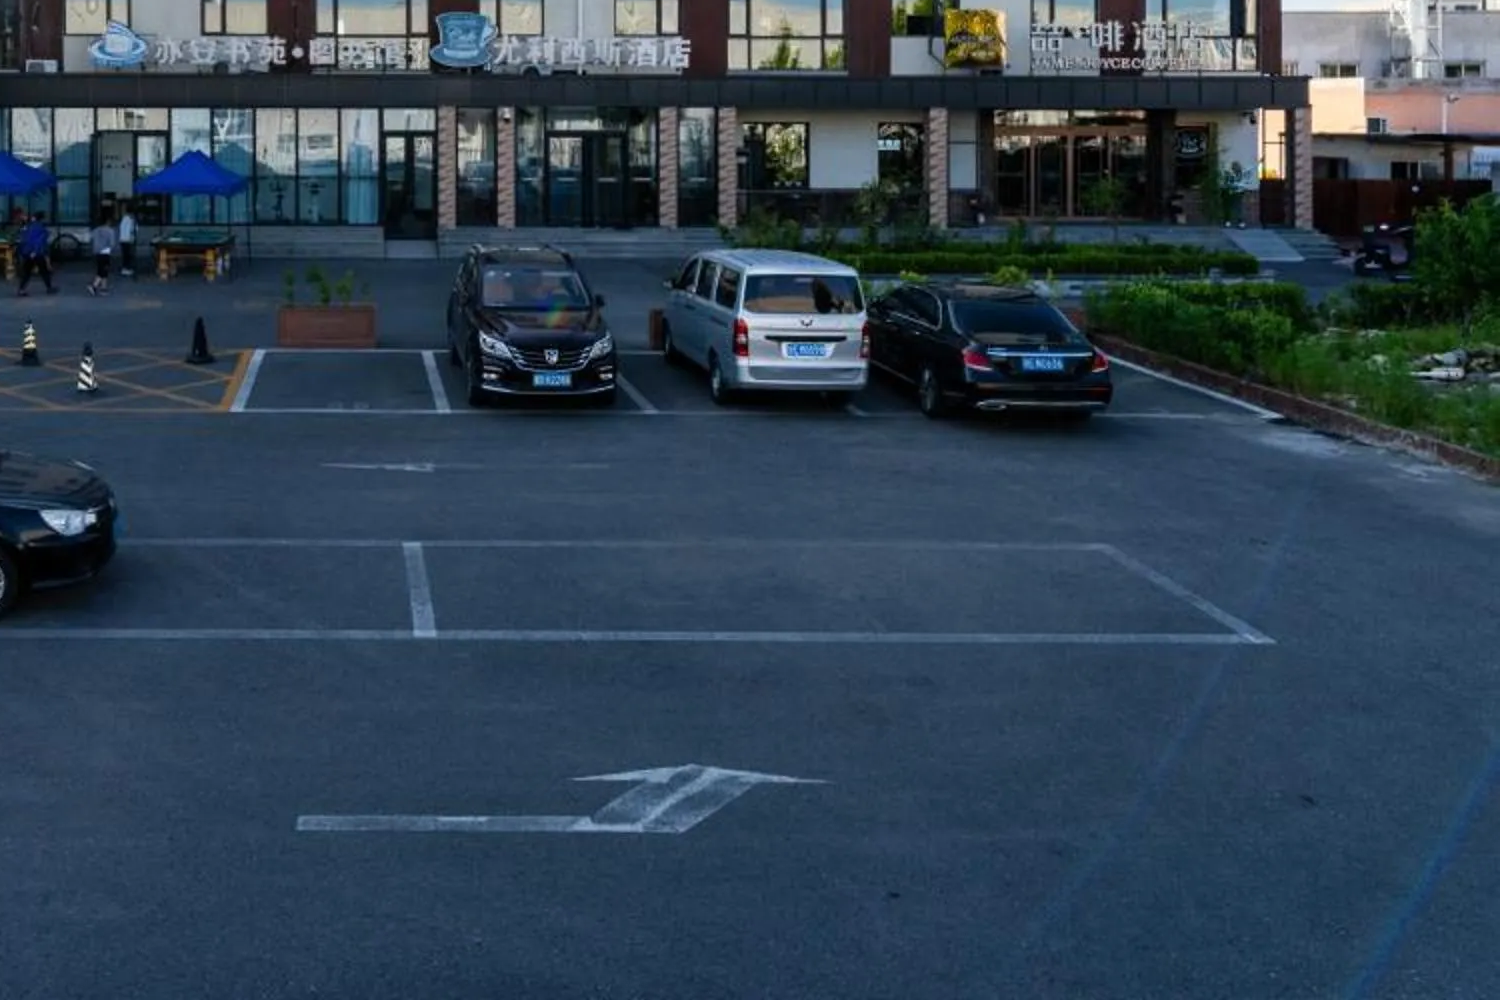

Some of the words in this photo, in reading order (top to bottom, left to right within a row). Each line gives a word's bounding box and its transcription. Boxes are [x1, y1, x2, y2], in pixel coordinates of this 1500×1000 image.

[493, 36, 692, 69] 尤利西斯酒店
